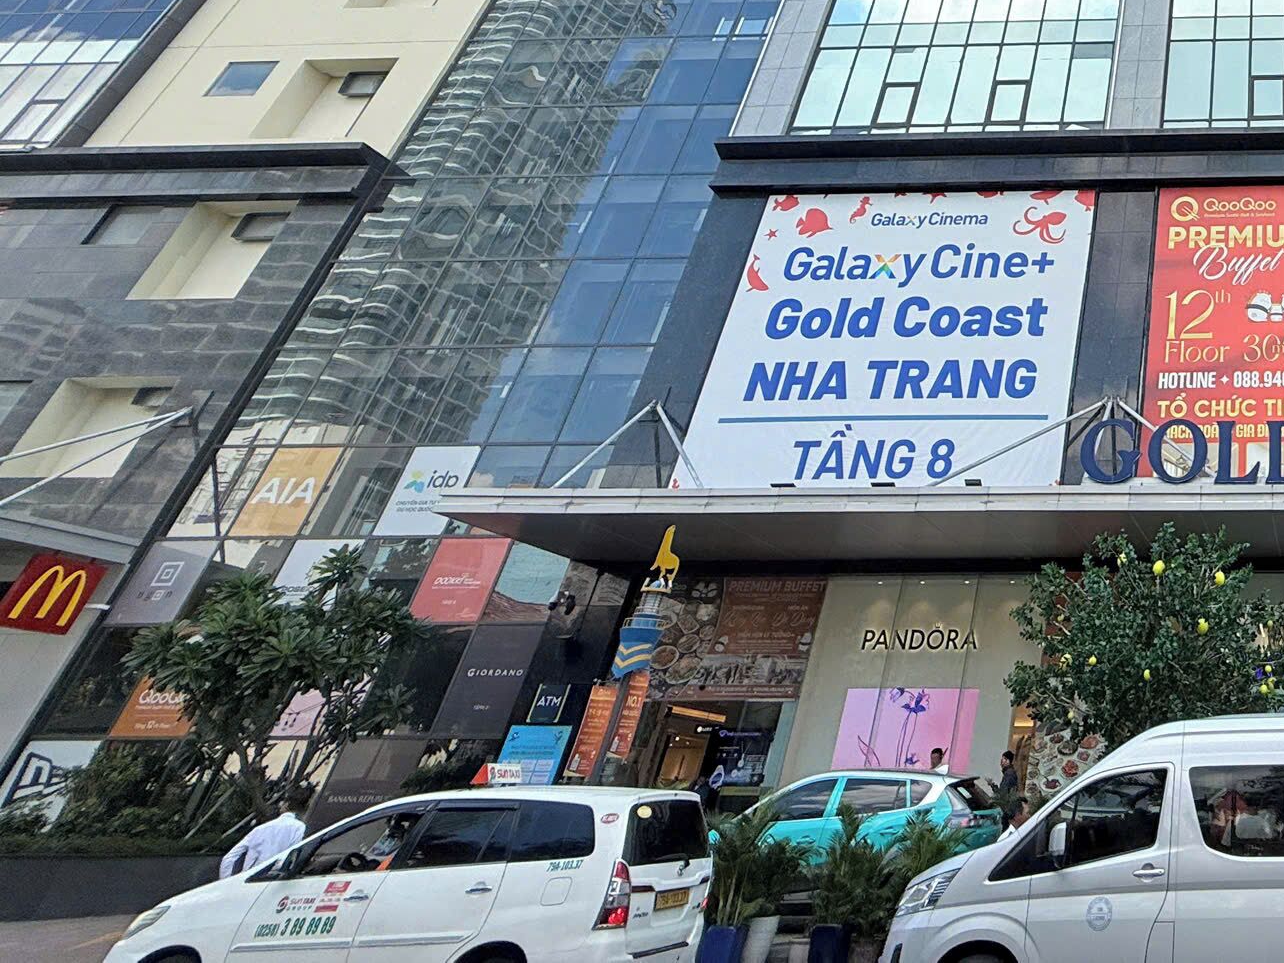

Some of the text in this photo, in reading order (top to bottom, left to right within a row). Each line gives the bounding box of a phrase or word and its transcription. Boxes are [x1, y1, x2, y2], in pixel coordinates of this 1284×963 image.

[1203, 197, 1277, 212] QooQoo
[870, 211, 989, 229] Galaxy Cinema
[783, 243, 1055, 288] Galaxy Cine+
[765, 296, 1049, 340] Gold Coast
[1164, 339, 1231, 364] Floor
[743, 358, 1038, 402] NHA TRANG
[1157, 371, 1217, 390] HOTLINE
[1157, 392, 1188, 418] TỔ
[1194, 394, 1257, 418] CHỨC
[1235, 423, 1255, 438] GIA
[793, 423, 956, 480] TẦNG 8
[251, 476, 316, 505] AIA
[729, 580, 827, 593] PREMIUM BUFFET
[861, 629, 978, 650] PANDORA
[467, 669, 524, 677] GIORDANO
[537, 696, 562, 707] ATM
[281, 917, 291, 936] 3
[290, 917, 306, 936] 89
[305, 916, 321, 936] 89
[320, 915, 337, 934] 89
